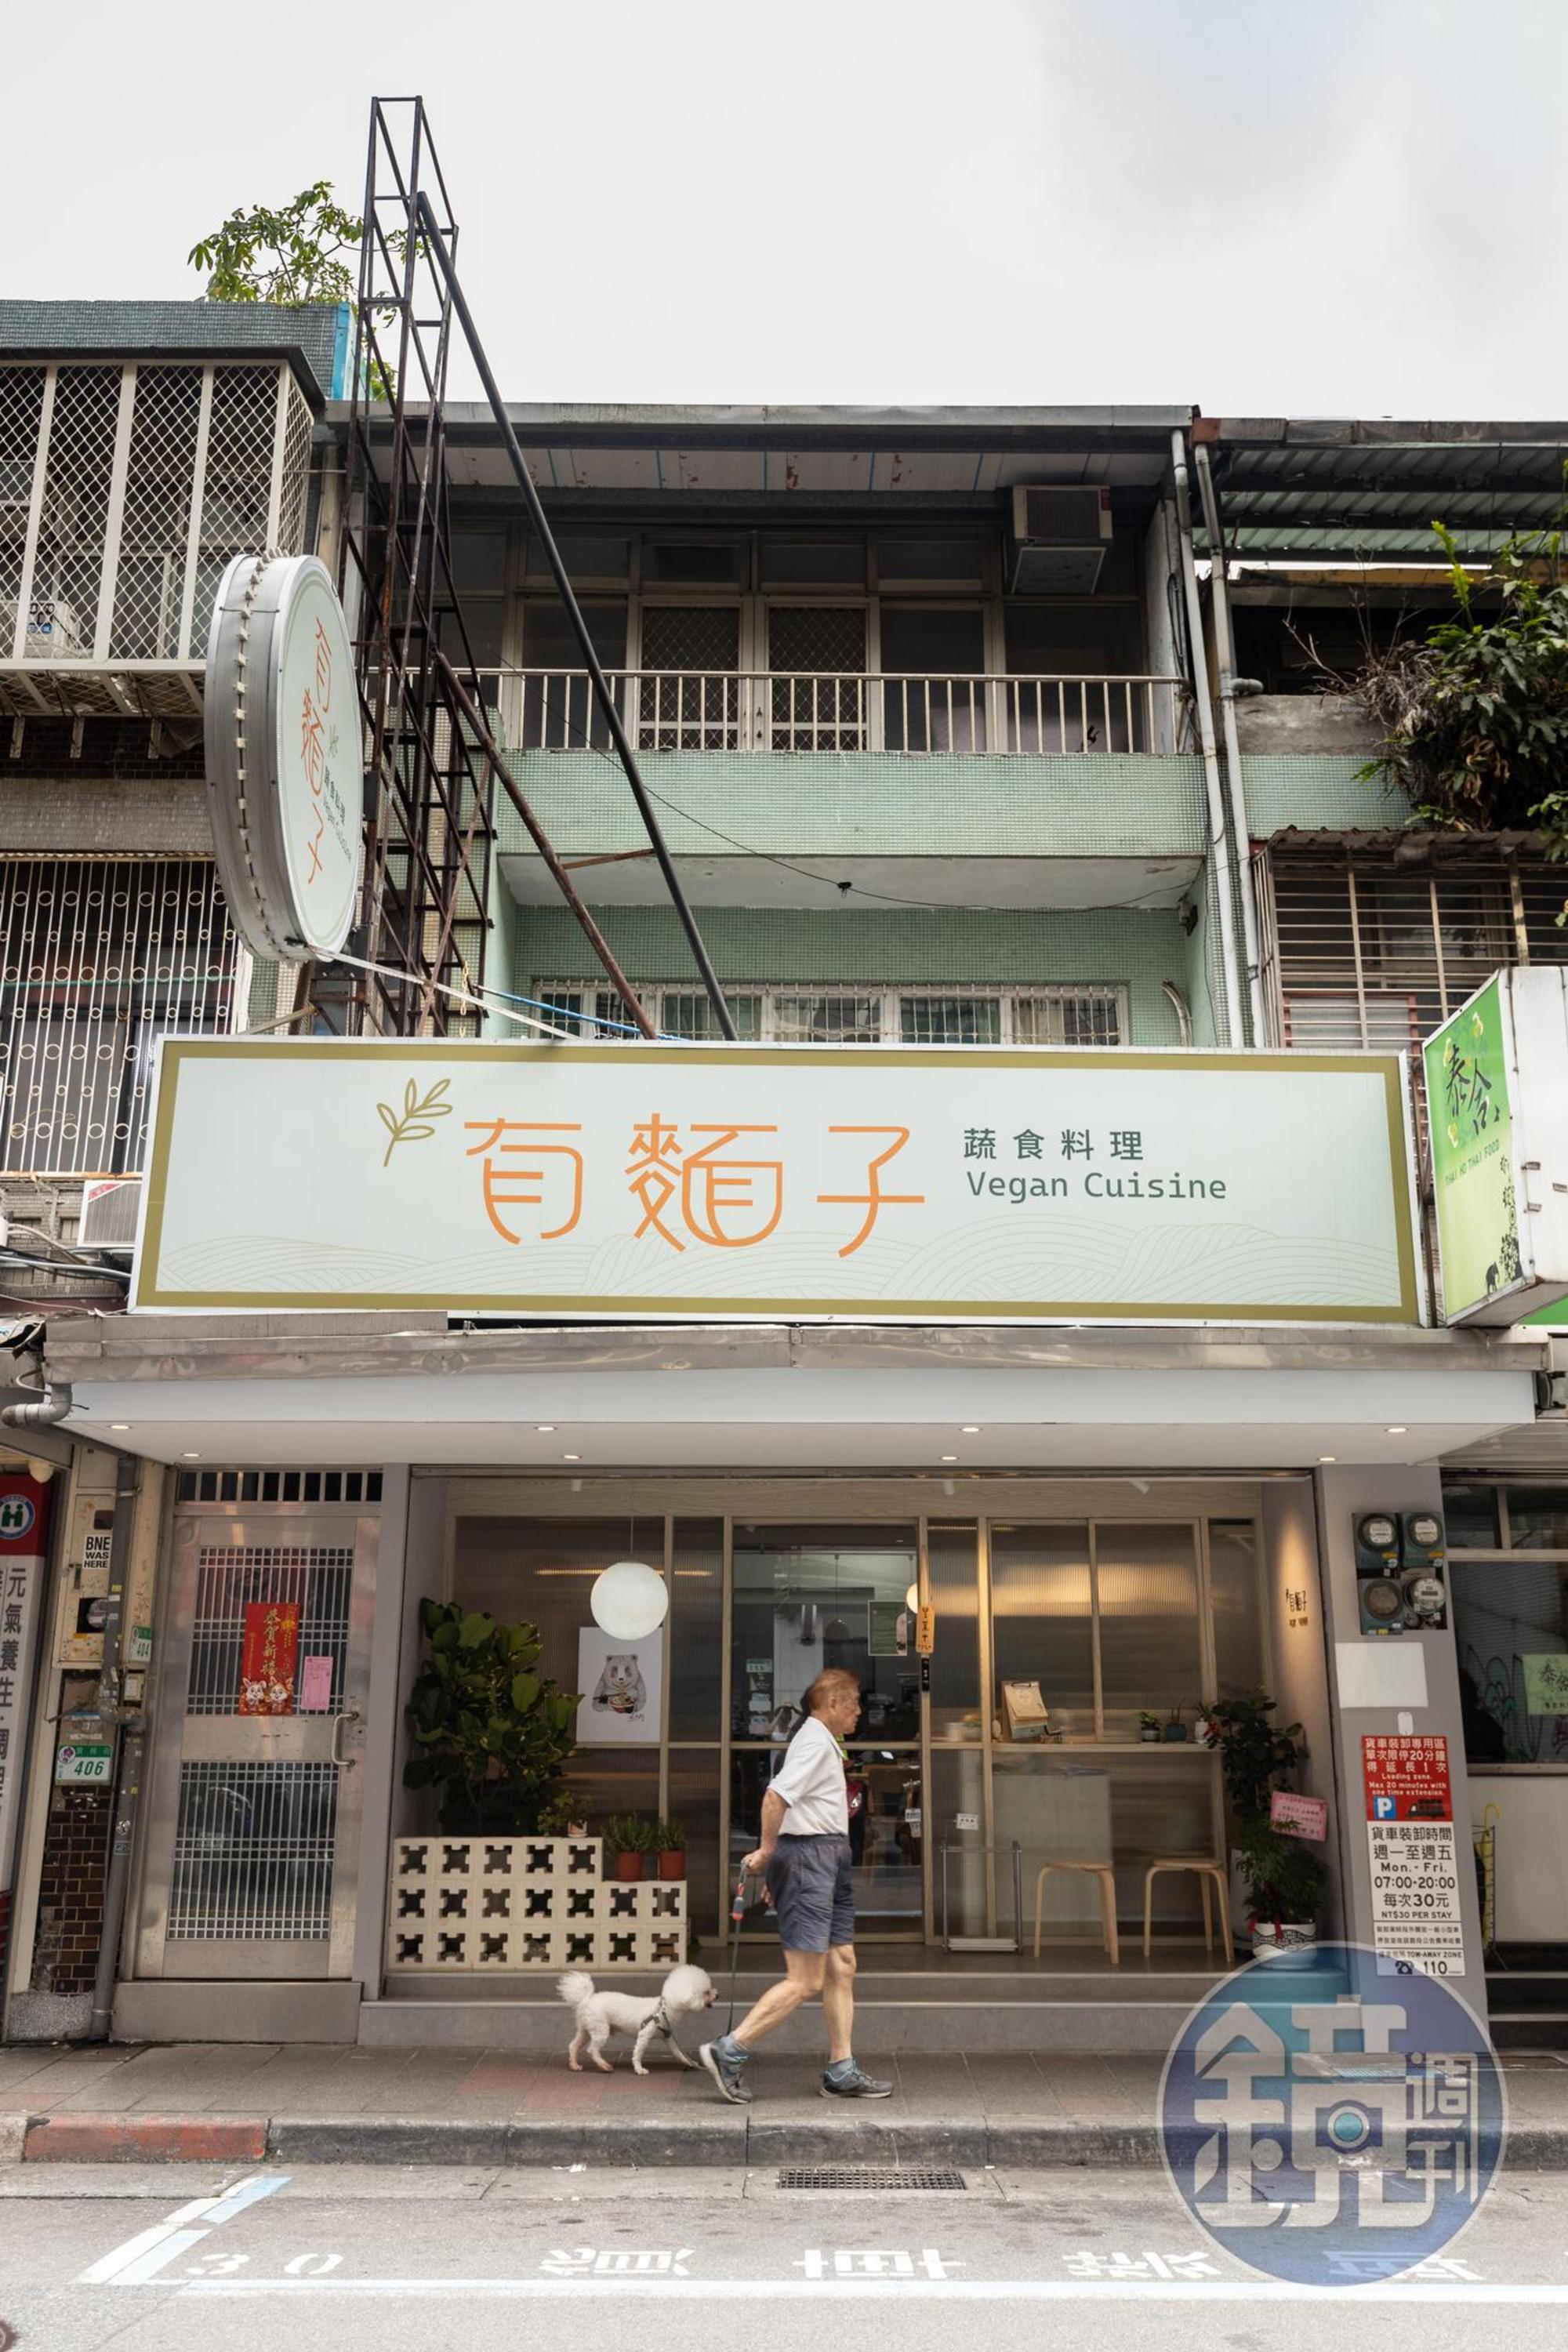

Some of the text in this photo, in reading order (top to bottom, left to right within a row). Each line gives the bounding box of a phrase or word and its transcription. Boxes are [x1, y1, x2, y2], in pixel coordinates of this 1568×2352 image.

[963, 1127, 1144, 1161] 蔬食料理
[1484, 1139, 1499, 1156] FOOD
[464, 1113, 925, 1258] 有麵子
[966, 1171, 1227, 1204] Vegan Cuisine
[86, 1537, 111, 1551] BNE
[1366, 1737, 1445, 1749] 貨車裝卸專用區
[1366, 1749, 1446, 1762] 單次限停20分鐘
[74, 1760, 104, 1776] 406
[1372, 1826, 1452, 1841] 貨車裝卸時間
[1374, 1845, 1452, 1860] 週一至週五
[1381, 1862, 1411, 1872] Mon.
[1423, 1862, 1447, 1872] Fri.
[1374, 1876, 1455, 1889] 07:00-20:00
[1384, 1893, 1450, 1907] 每次30元
[1424, 1961, 1447, 1974] 110
